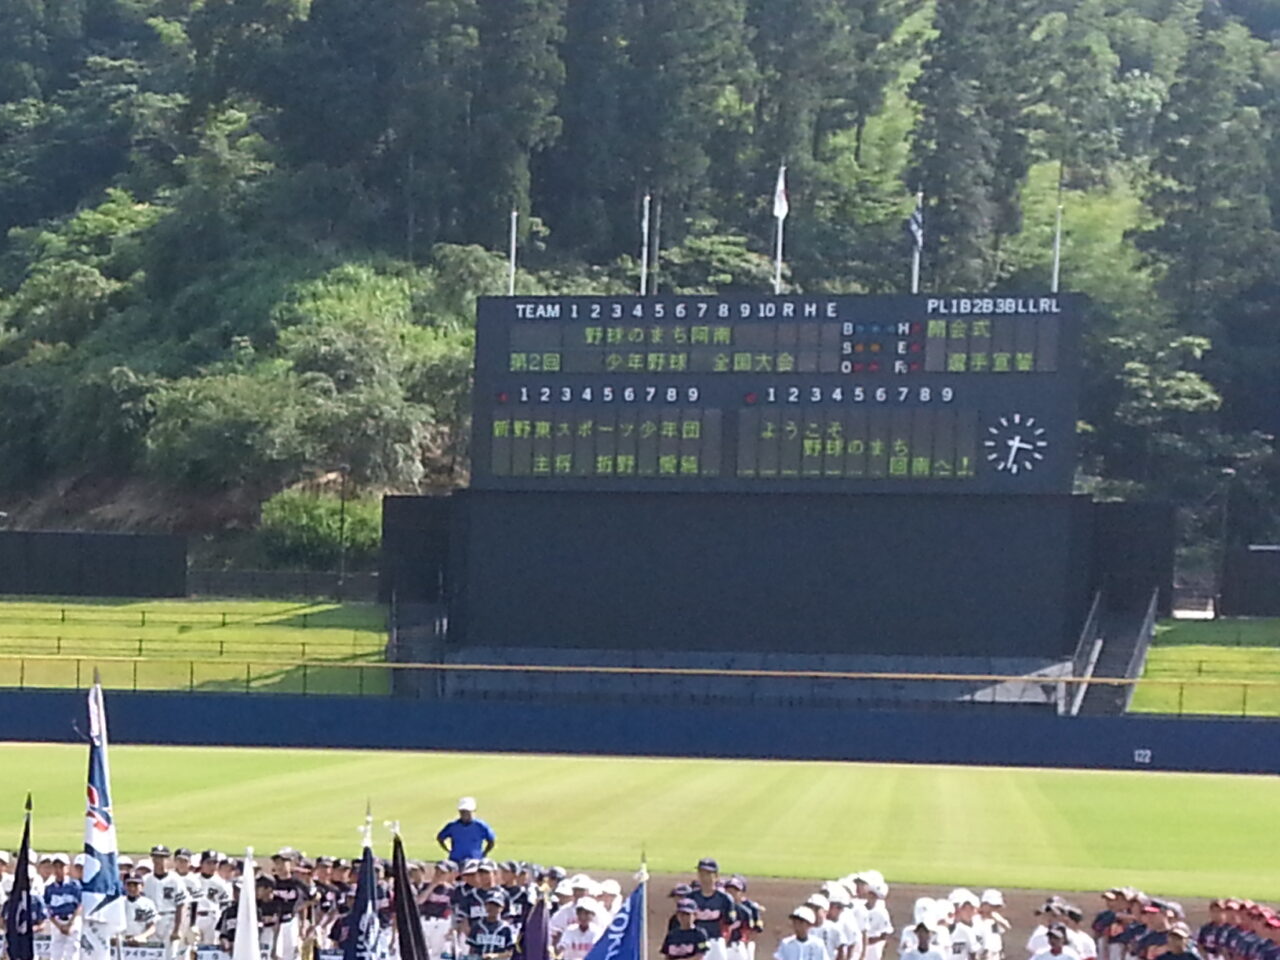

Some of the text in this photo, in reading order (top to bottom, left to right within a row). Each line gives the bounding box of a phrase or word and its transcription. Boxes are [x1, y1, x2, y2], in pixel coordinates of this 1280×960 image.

[516, 303, 837, 318] TEAM 1 2 3 4 5 6 7 8 9 10 R H E
[842, 322, 853, 336] B
[898, 322, 909, 336] H
[842, 341, 852, 354] S
[897, 341, 907, 354] E
[714, 352, 795, 372] 全国大会
[520, 387, 698, 401] 1 2 3 4 5 6 7 8 9
[768, 387, 953, 401] 1 2 3 4 5 6 7 8 9
[761, 421, 843, 439] ようこそ
[803, 438, 908, 457] 野球のまち
